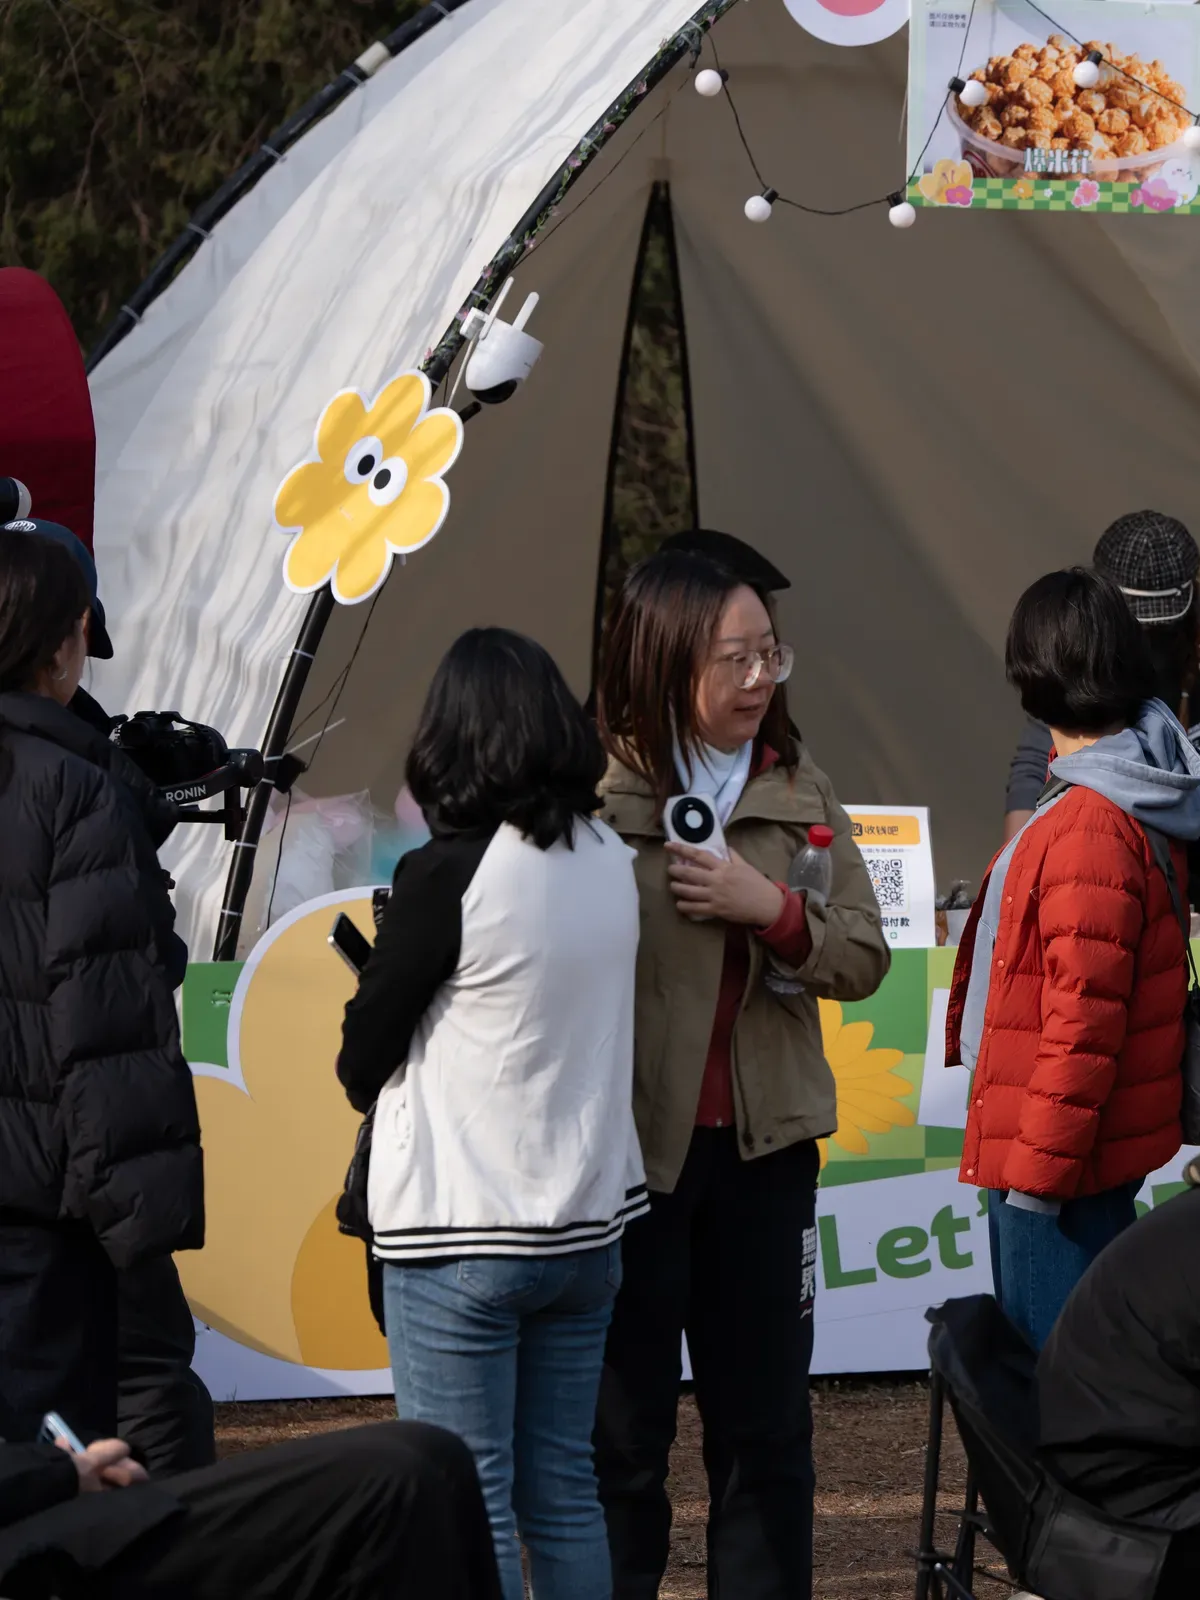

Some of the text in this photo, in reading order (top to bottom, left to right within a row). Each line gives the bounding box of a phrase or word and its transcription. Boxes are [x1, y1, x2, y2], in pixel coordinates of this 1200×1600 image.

[1024, 147, 1092, 174] 爆米花
[165, 784, 207, 802] RONIN
[864, 824, 899, 836] 收钱吧
